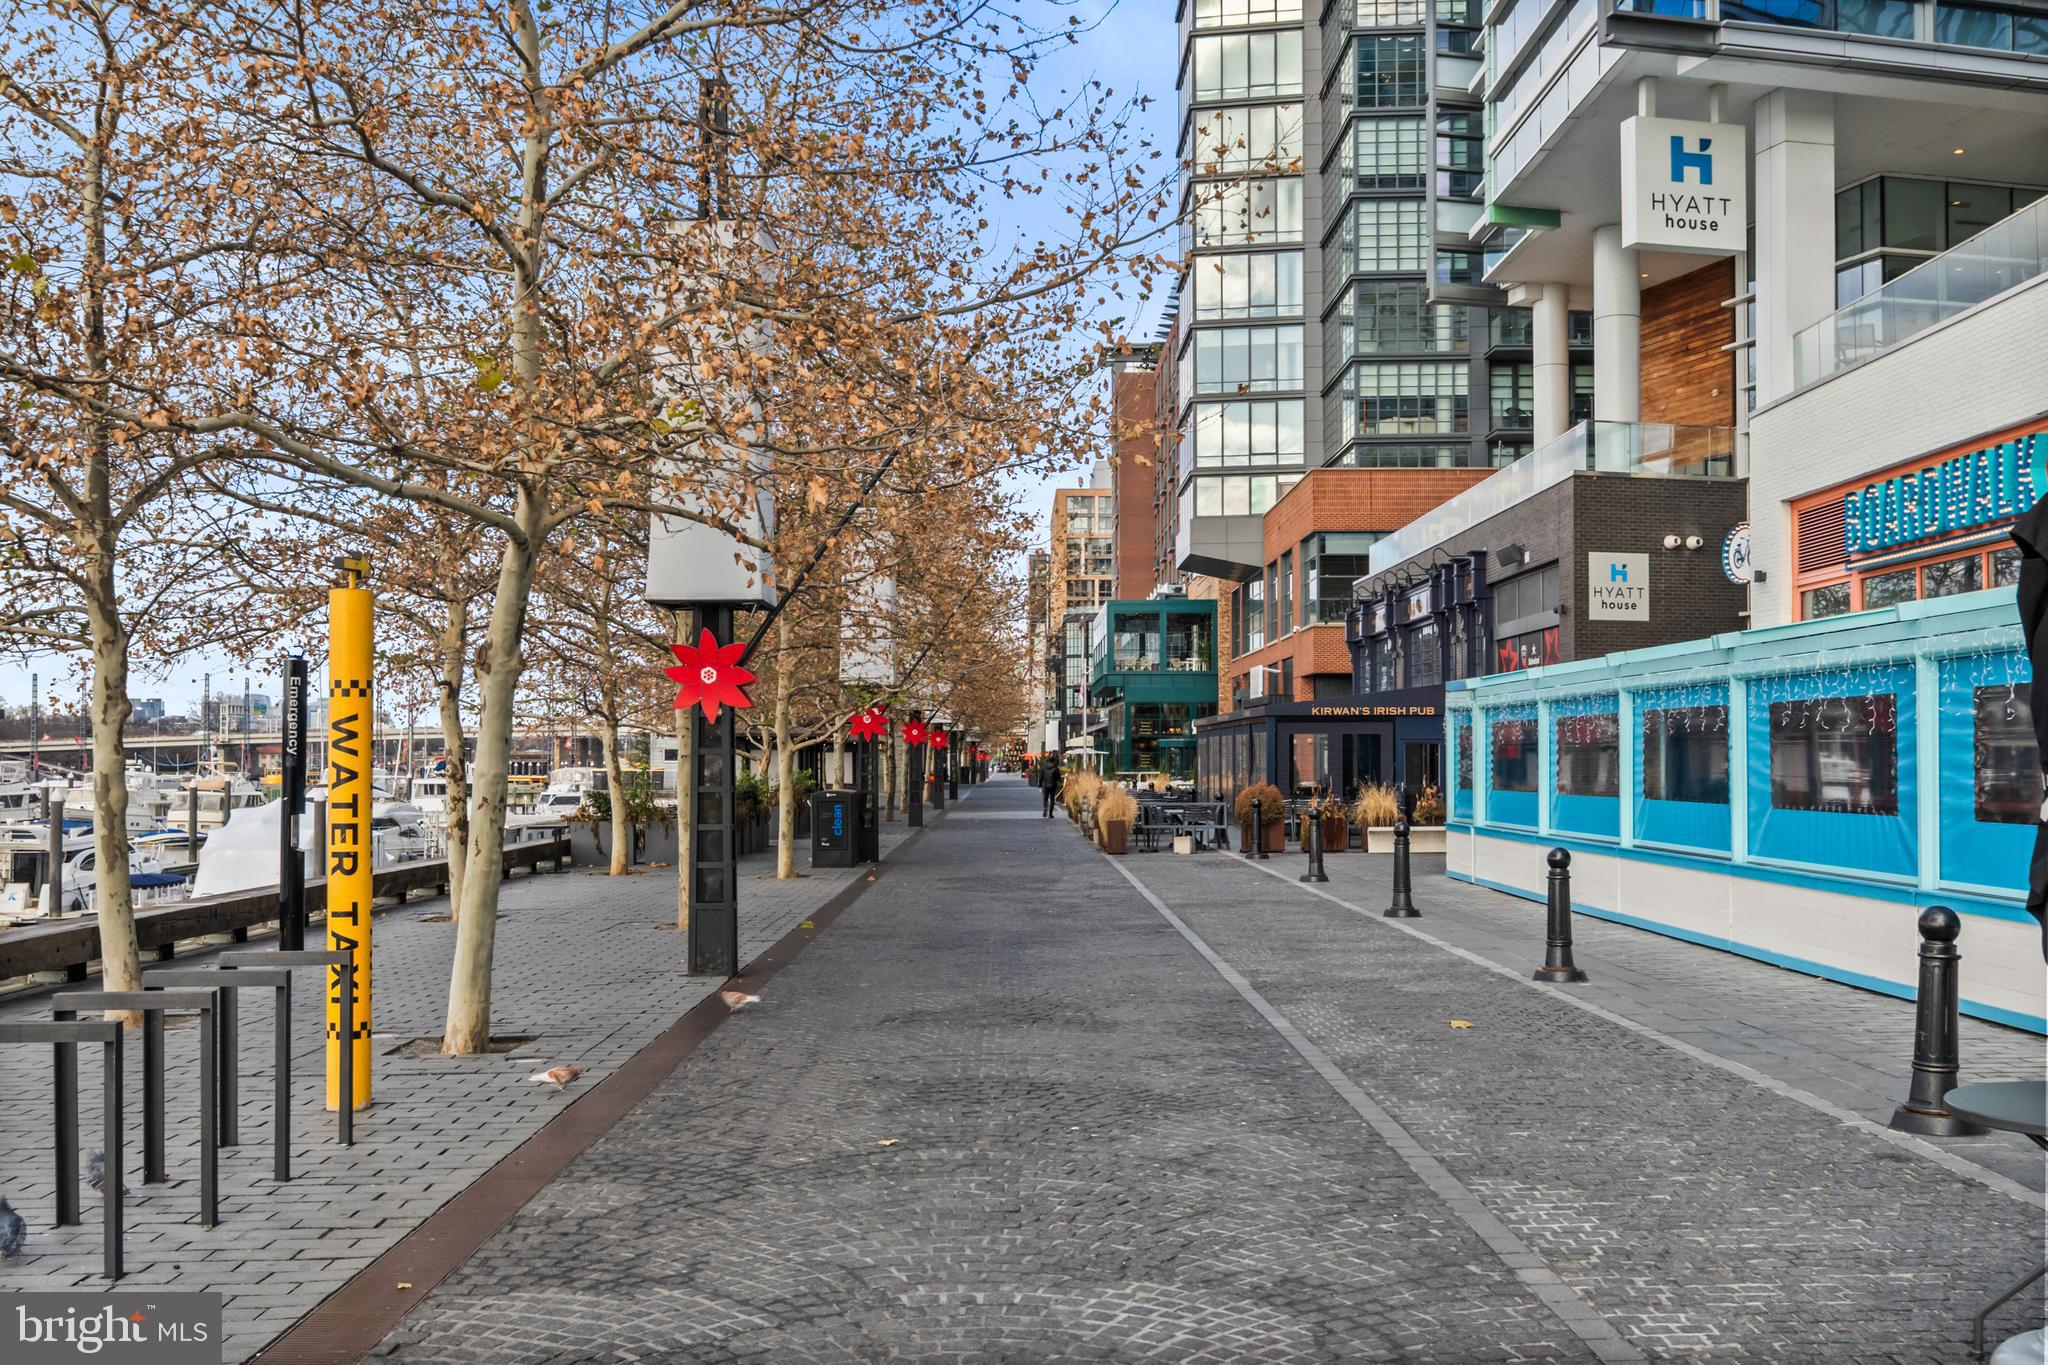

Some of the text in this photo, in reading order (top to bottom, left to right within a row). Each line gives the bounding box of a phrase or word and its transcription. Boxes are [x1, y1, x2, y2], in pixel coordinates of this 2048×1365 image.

[1651, 192, 1732, 217] HYATT
[1665, 213, 1719, 232] house
[1845, 432, 2038, 555] BOARDWALK
[1593, 586, 1645, 600] HYATT
[1601, 599, 1638, 610] house
[286, 676, 301, 756] Emergency
[1311, 706, 1436, 716] KIRWAN'S IRISH PUB
[331, 713, 359, 876] WATER
[832, 803, 843, 837] clean
